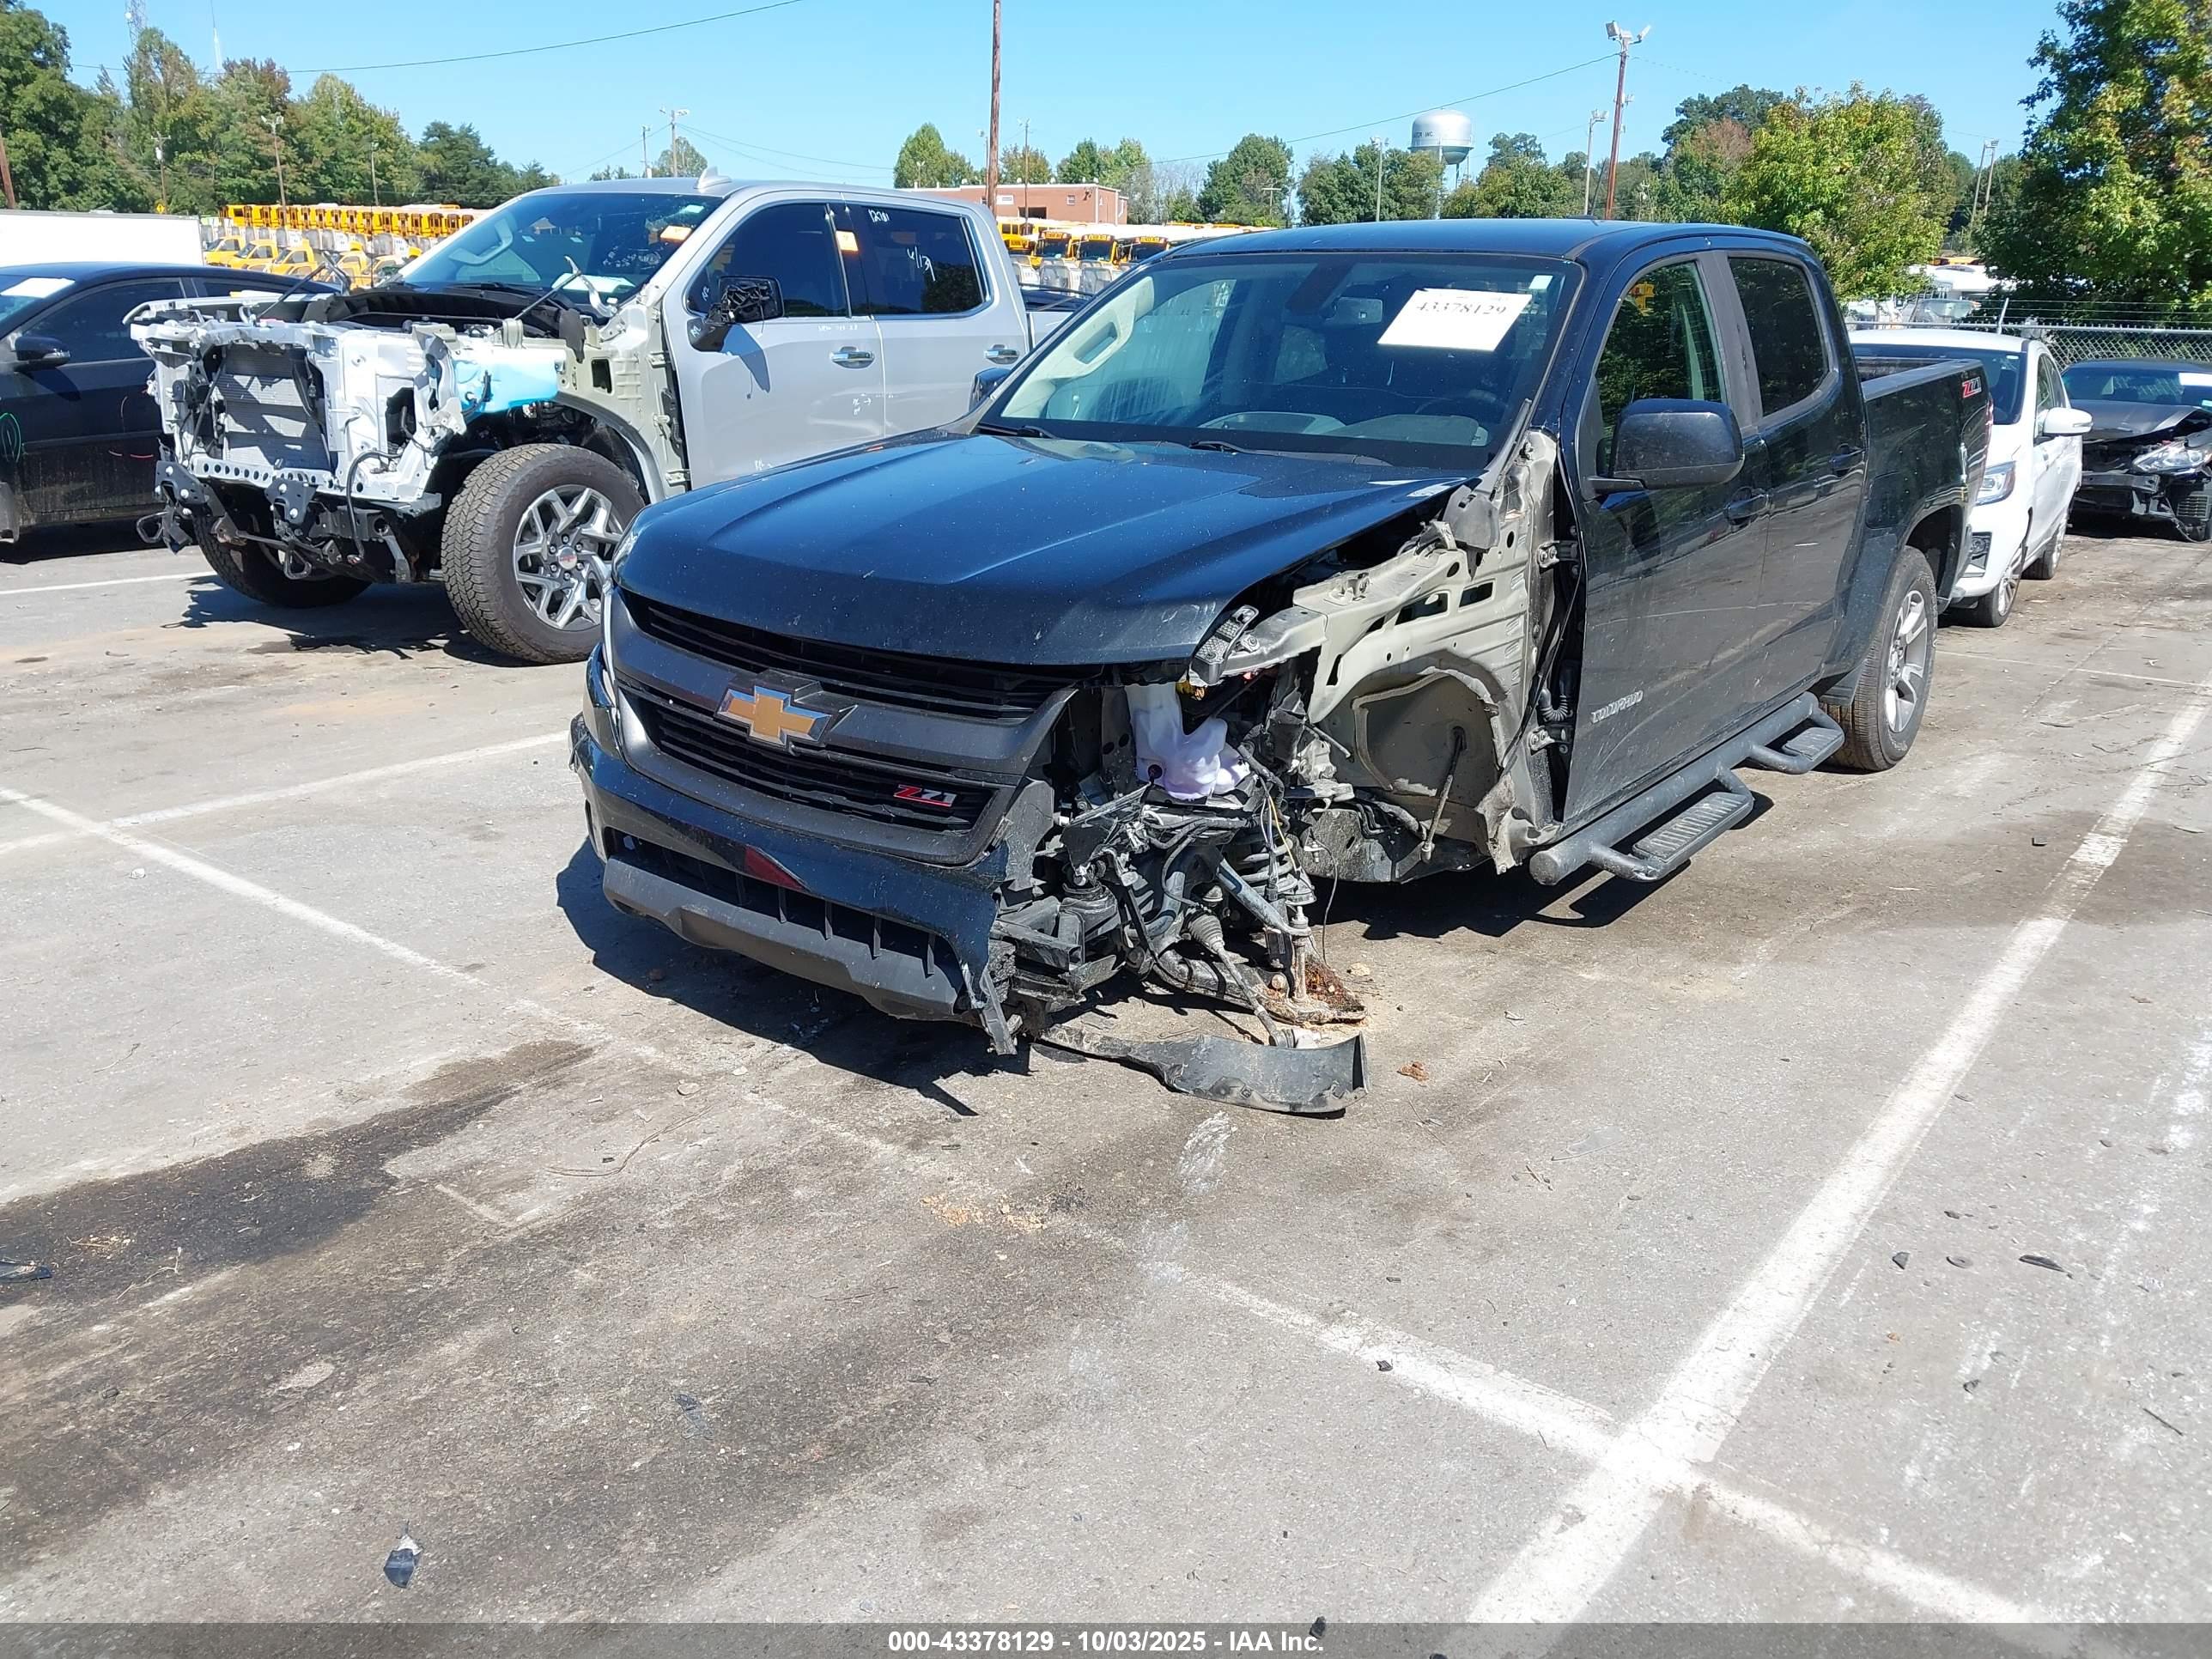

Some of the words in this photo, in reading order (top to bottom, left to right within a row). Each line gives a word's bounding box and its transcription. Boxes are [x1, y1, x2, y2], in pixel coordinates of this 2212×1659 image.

[1415, 301, 1507, 315] 43378129
[1961, 376, 1983, 398] Z71
[893, 784, 957, 807] Z71
